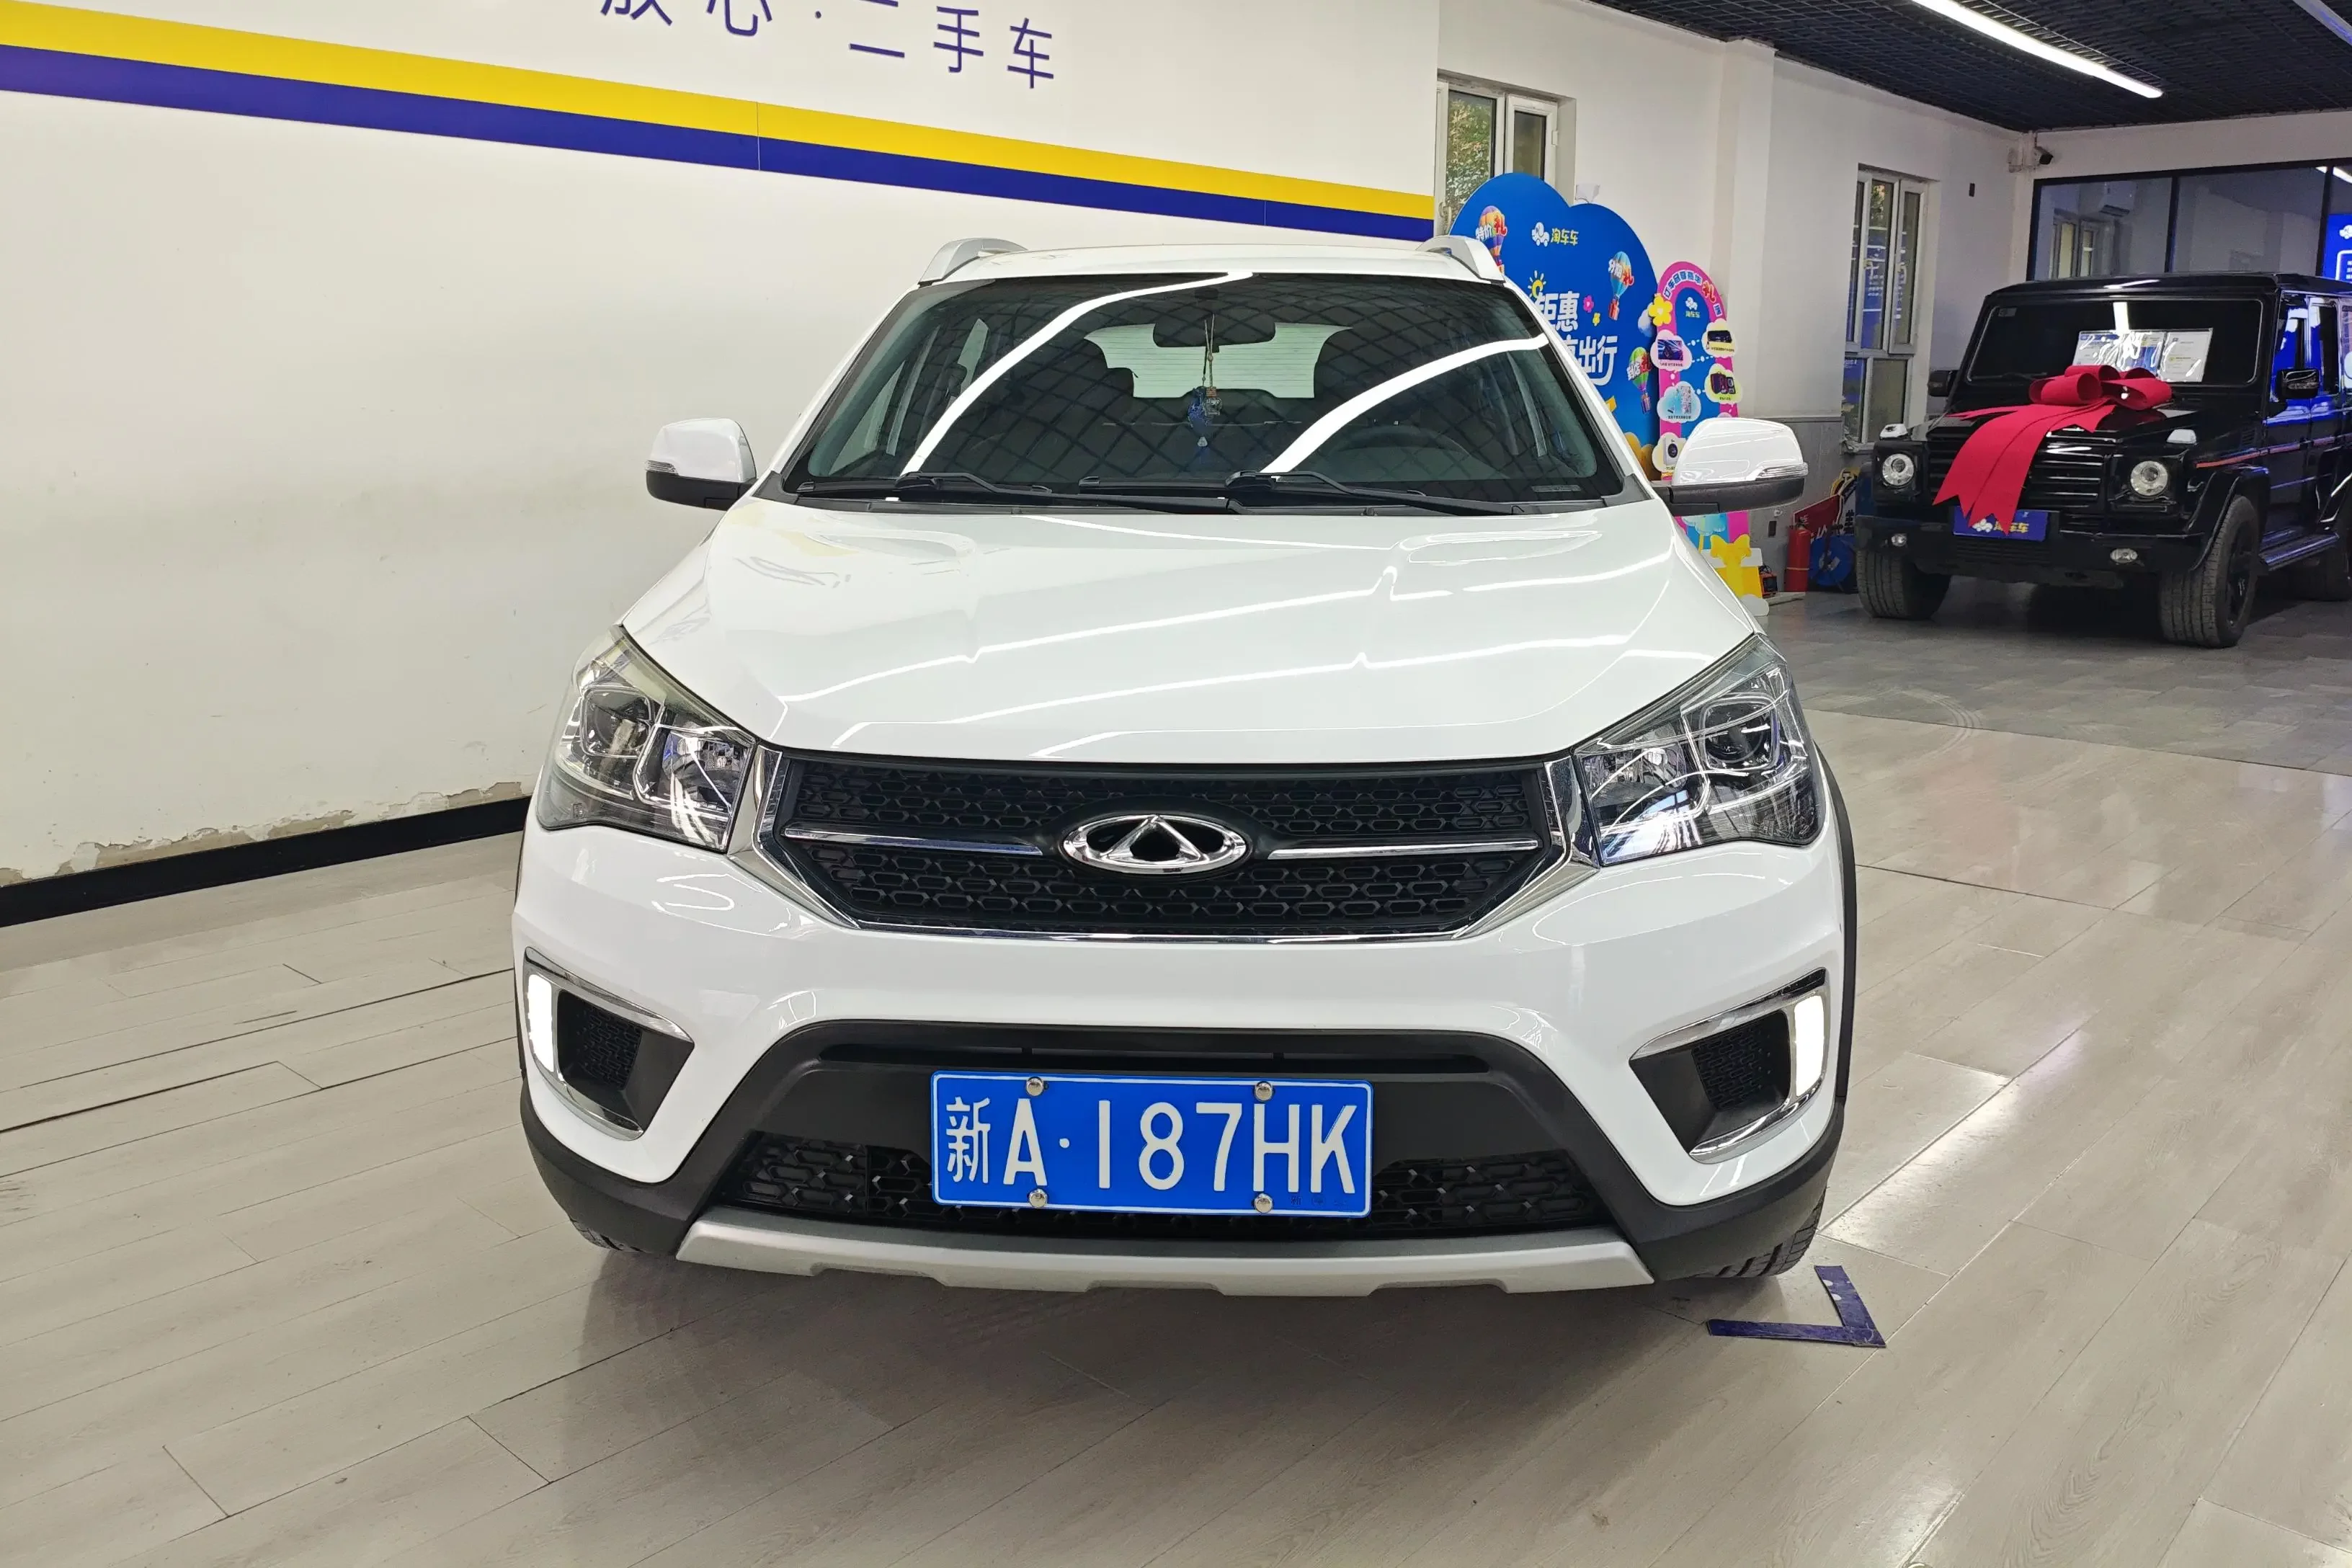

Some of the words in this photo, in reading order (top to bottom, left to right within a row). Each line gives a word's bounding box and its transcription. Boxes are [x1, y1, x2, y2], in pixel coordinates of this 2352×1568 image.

[600, 0, 1054, 89] 心·二手车
[1551, 228, 1579, 246] 淘车车
